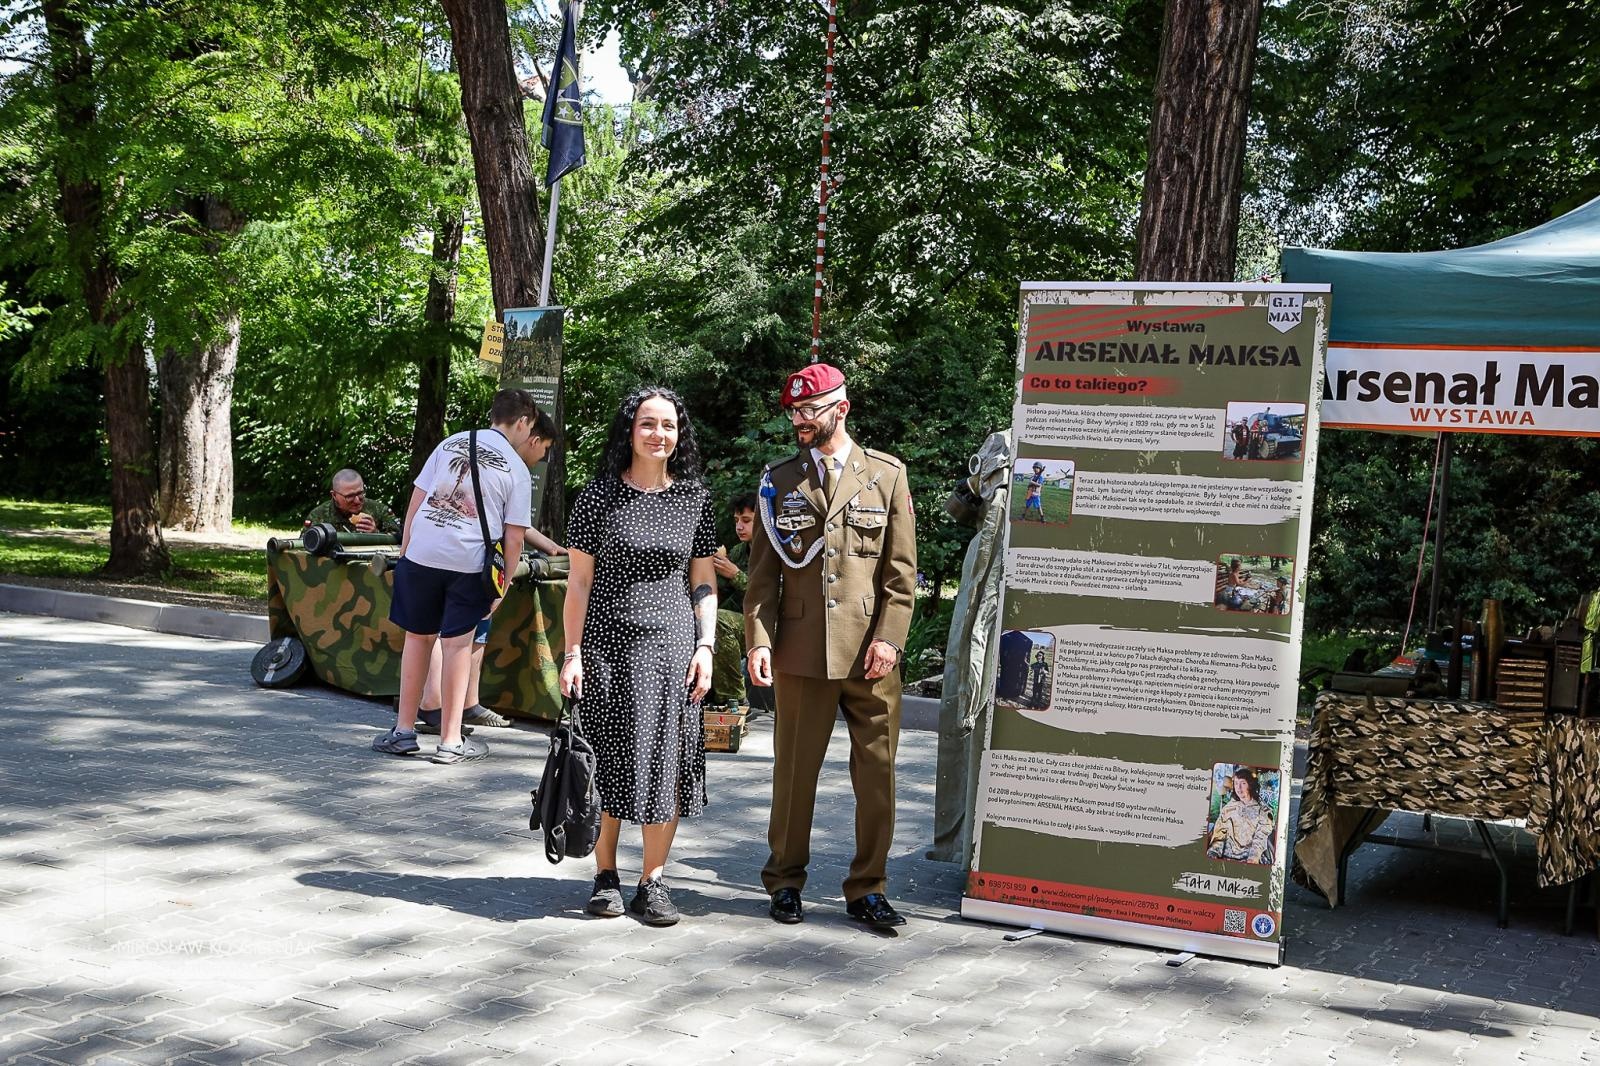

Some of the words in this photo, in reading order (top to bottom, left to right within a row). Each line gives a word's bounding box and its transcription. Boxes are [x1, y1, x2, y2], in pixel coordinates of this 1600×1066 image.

[1273, 297, 1298, 308] G.I.
[1269, 310, 1300, 323] MAX
[1126, 320, 1205, 335] Wystawa
[1035, 341, 1179, 365] ARSENAŁ
[1189, 344, 1301, 367] MAKSA
[1030, 377, 1050, 389] Co
[1054, 378, 1070, 390] to
[1075, 378, 1148, 393] takiego?
[1410, 407, 1535, 425] WYSTAWA
[1183, 876, 1211, 891] Tata
[1218, 879, 1256, 897] Maksa
[1193, 907, 1215, 919] walczy
